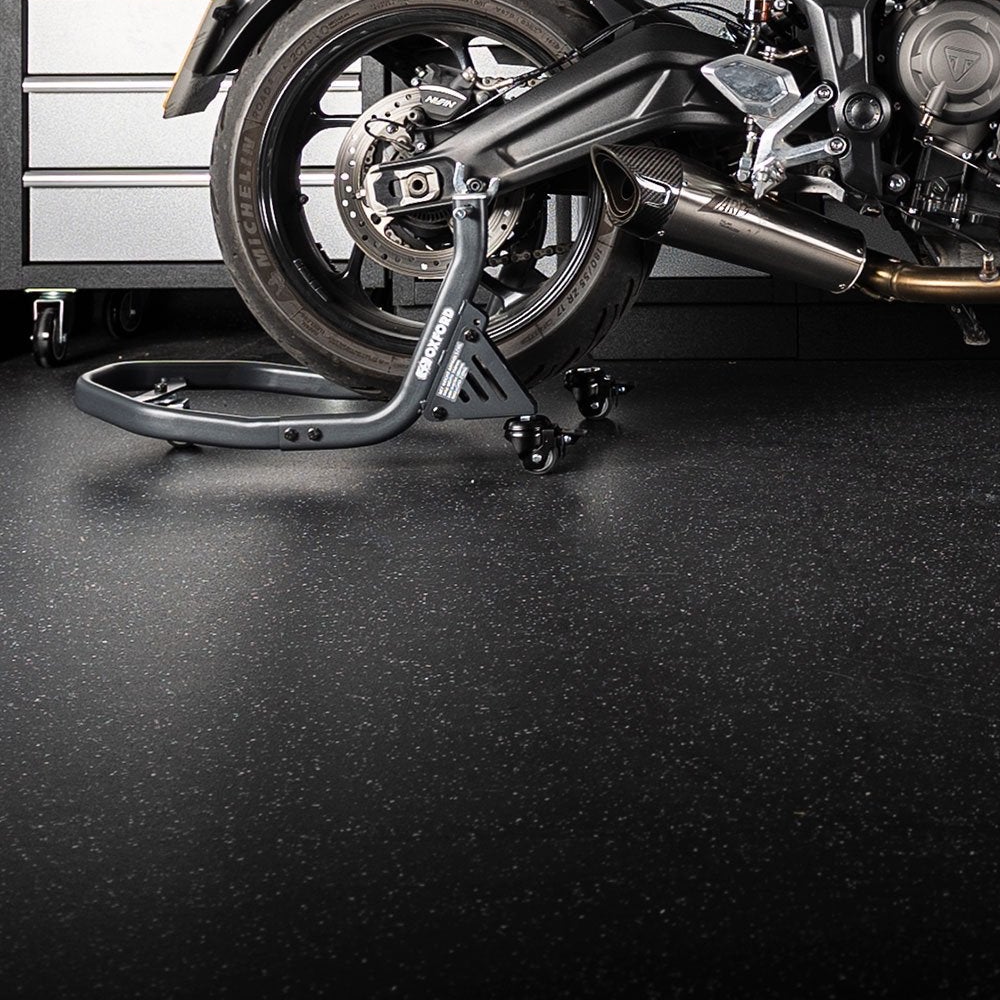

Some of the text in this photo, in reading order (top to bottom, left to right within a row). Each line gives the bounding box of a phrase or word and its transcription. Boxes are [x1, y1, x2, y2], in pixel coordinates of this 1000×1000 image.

[238, 135, 272, 268] MICHELIN
[556, 247, 603, 317] 180/55 ZR 17
[424, 306, 455, 358] OXFORD
